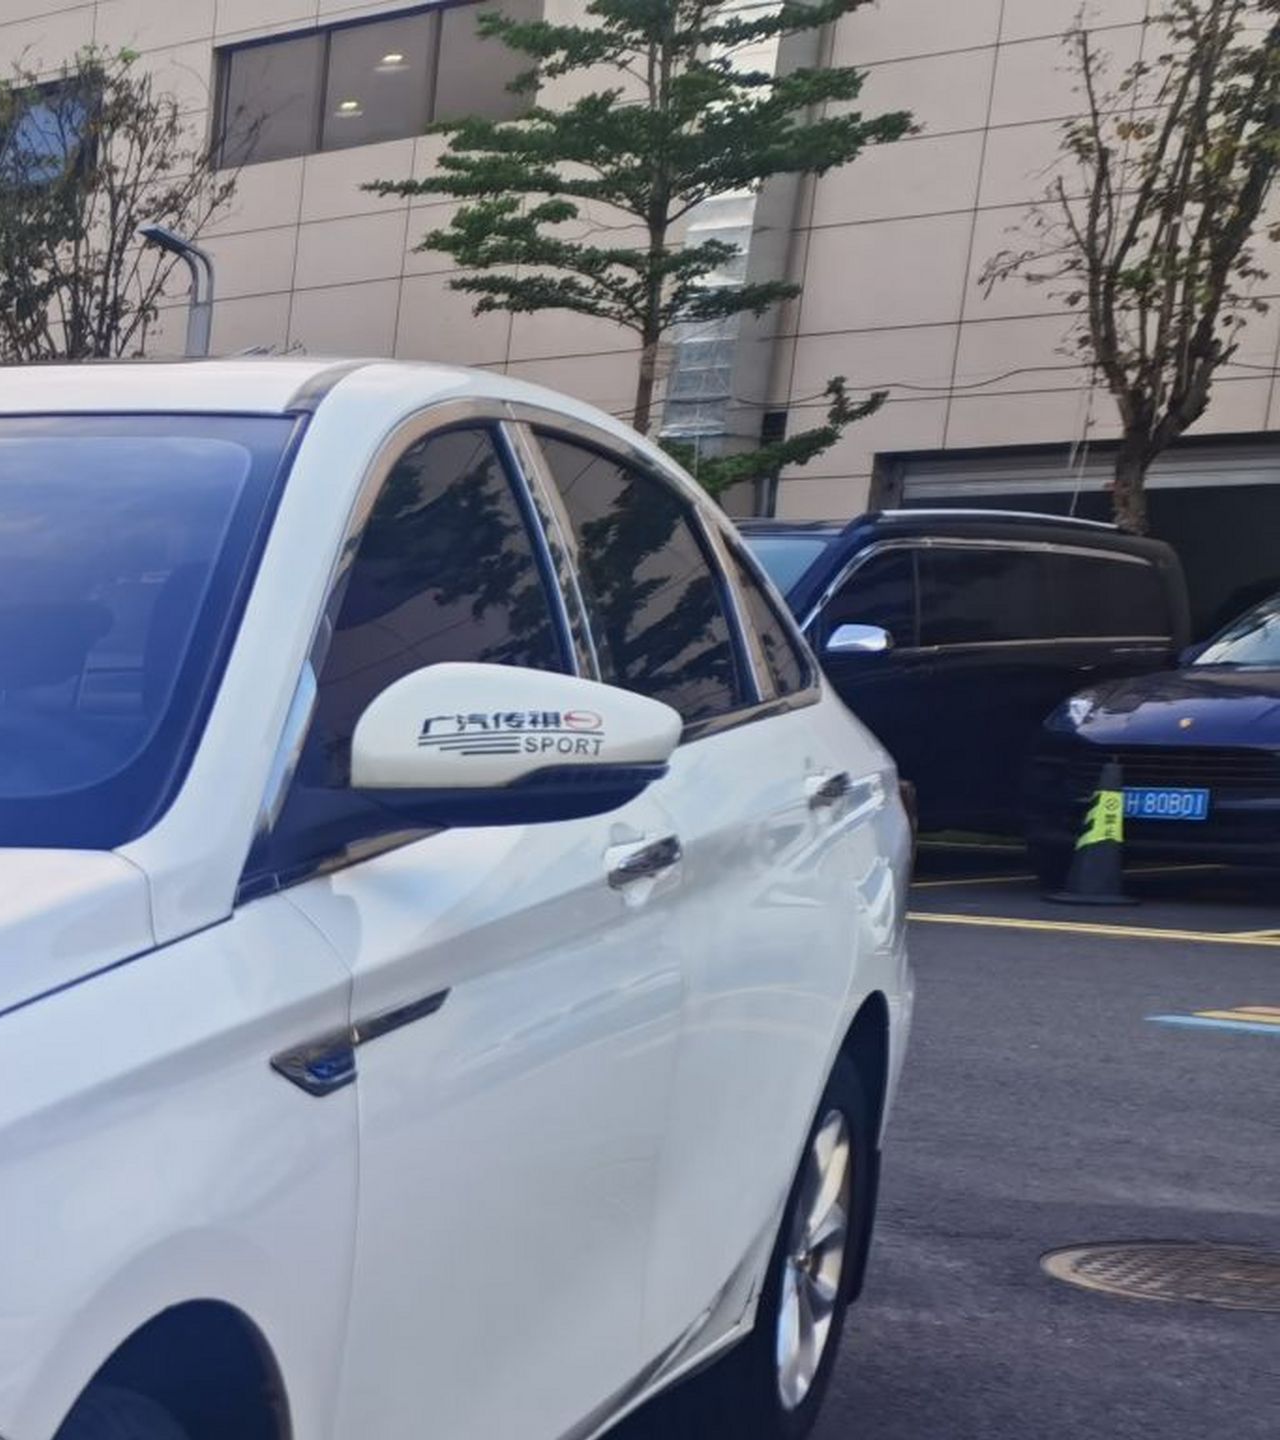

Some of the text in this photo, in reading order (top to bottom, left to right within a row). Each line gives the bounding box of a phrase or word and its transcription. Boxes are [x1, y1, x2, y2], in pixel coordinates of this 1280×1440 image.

[422, 711, 561, 735] 广汽传祺
[524, 736, 604, 756] SPORT
